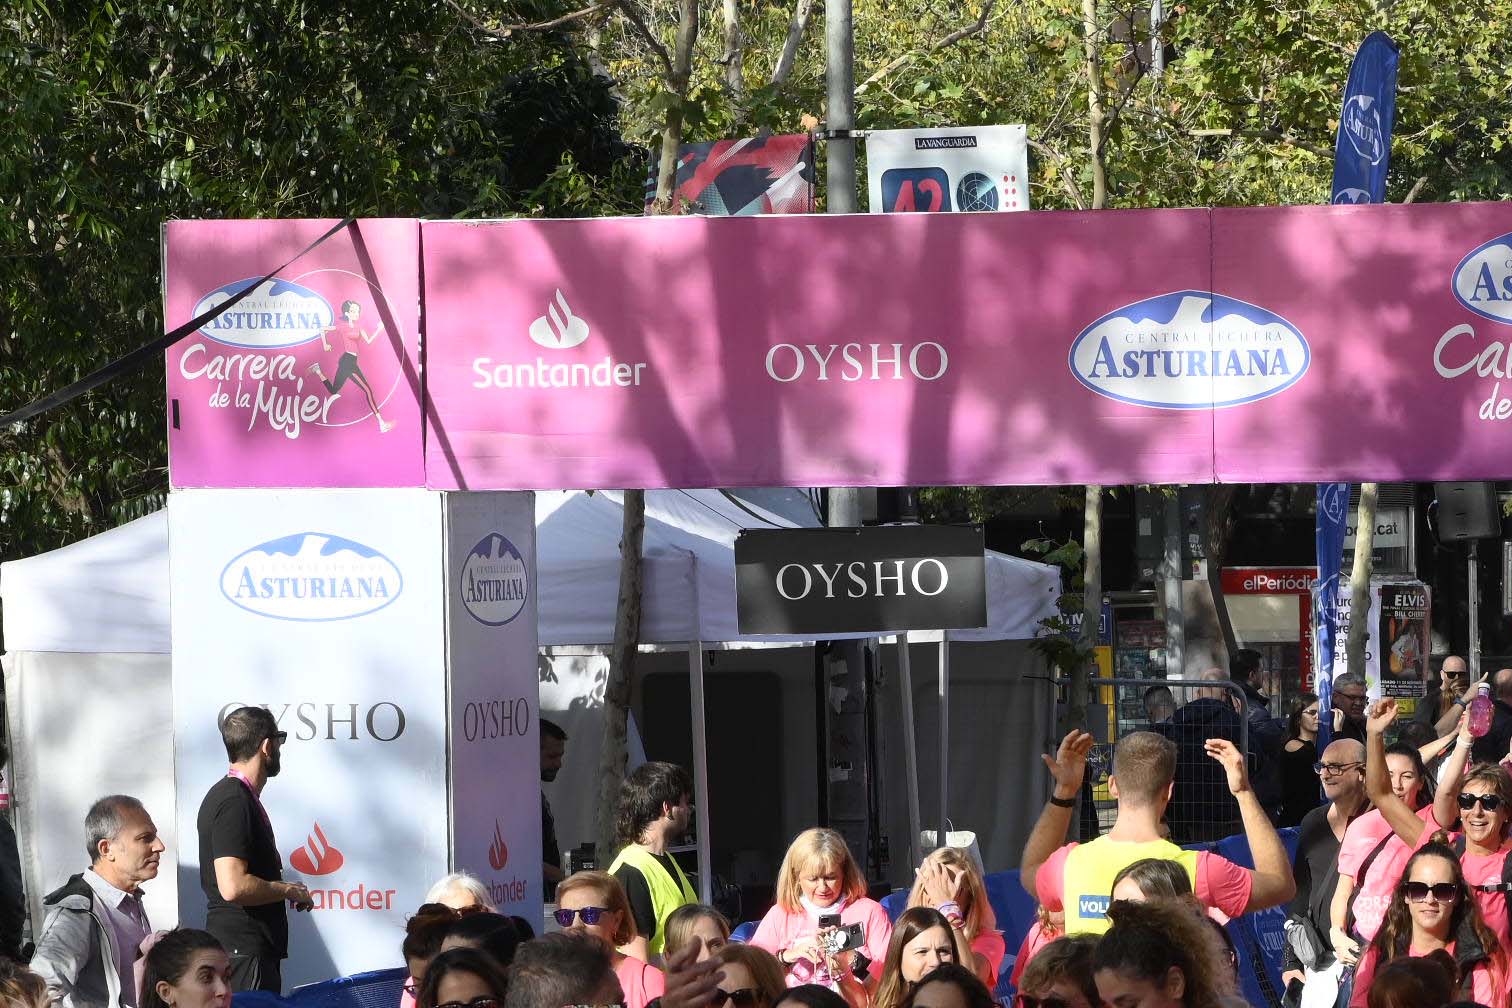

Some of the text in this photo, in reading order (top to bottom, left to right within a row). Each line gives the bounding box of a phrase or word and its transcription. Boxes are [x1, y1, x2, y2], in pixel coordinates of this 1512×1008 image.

[204, 303, 322, 331] ASTURIANA
[1087, 335, 1292, 379] ASTURIANA
[1125, 330, 1283, 345] CENTRAL LECHERA
[179, 343, 297, 382] Carrera
[472, 357, 647, 389] Santander
[765, 341, 949, 383] OYSHO
[208, 376, 342, 440] de la Mujer
[235, 565, 390, 601] ASTURIANA
[466, 567, 525, 604] ASTURIANA
[776, 558, 949, 601] OYSHO
[1394, 594, 1425, 607] ELVIS
[218, 701, 406, 743] SHO
[464, 697, 530, 743] OYSHO
